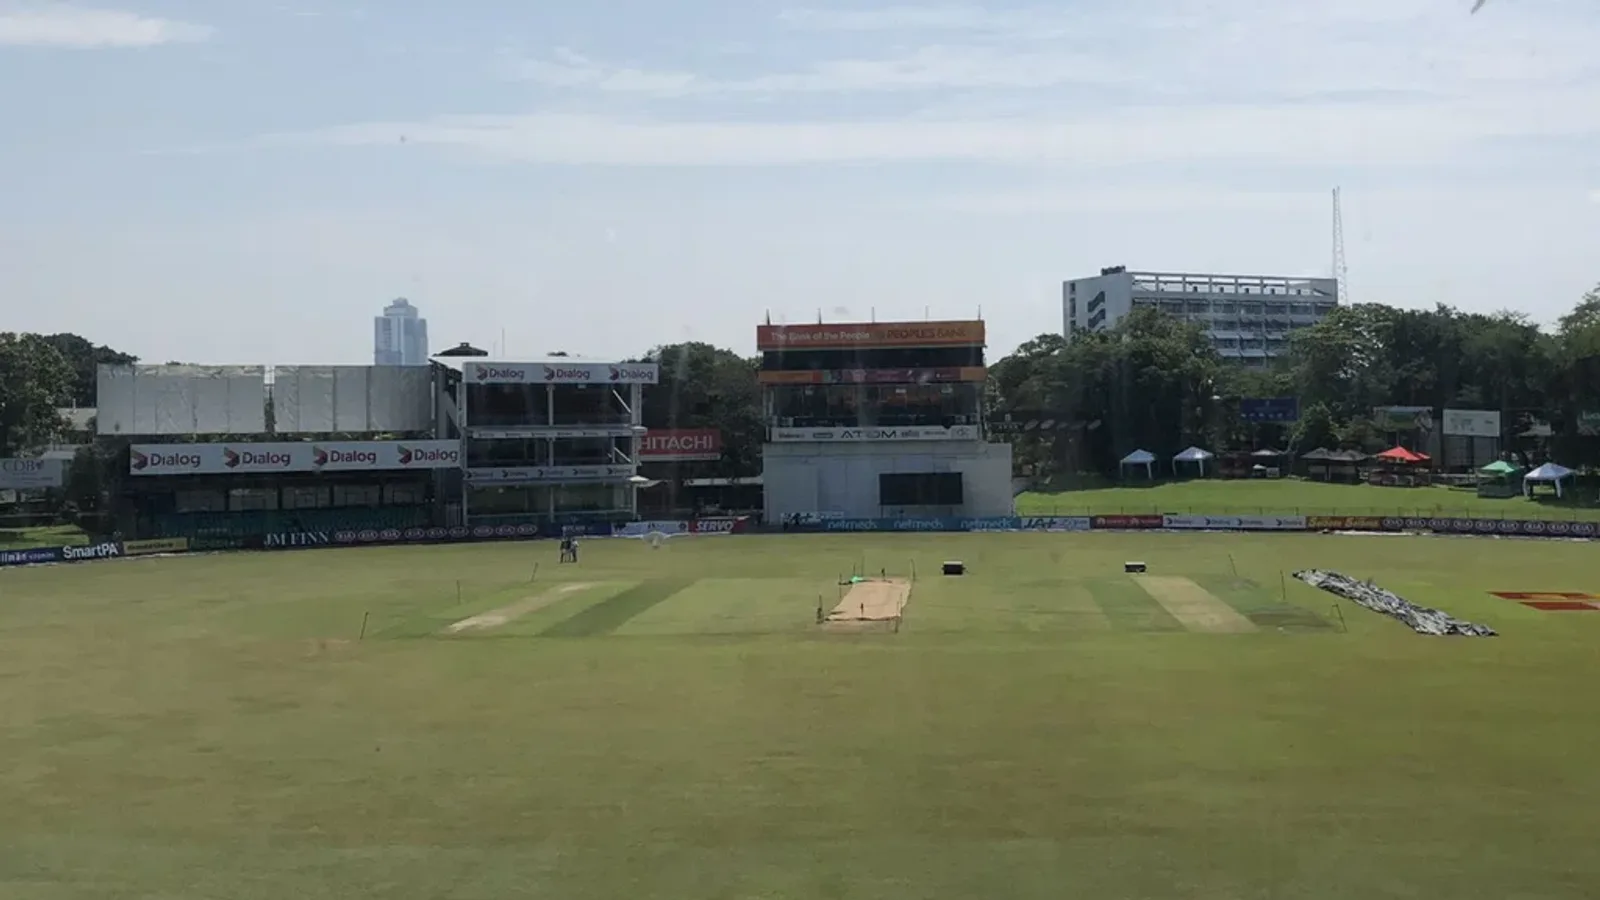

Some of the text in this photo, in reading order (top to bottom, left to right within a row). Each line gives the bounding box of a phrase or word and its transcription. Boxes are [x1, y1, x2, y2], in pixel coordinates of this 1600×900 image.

[772, 331, 870, 341] The Bank of the People
[489, 368, 525, 380] Dialog
[556, 368, 591, 380] Dialog
[620, 368, 654, 380] Dialog
[840, 430, 897, 438] ATOM
[639, 435, 713, 450] HITACHI
[150, 453, 201, 468] Dialog
[242, 451, 291, 466] Dialog
[331, 450, 376, 464] Dialog
[414, 448, 458, 462] Dialog
[696, 521, 733, 531] SERVO
[828, 519, 877, 529] netmeds
[893, 518, 943, 529] netmeds
[960, 518, 1012, 529] netmeds
[264, 531, 329, 545] JM FINN
[63, 542, 118, 558] SmartPA
